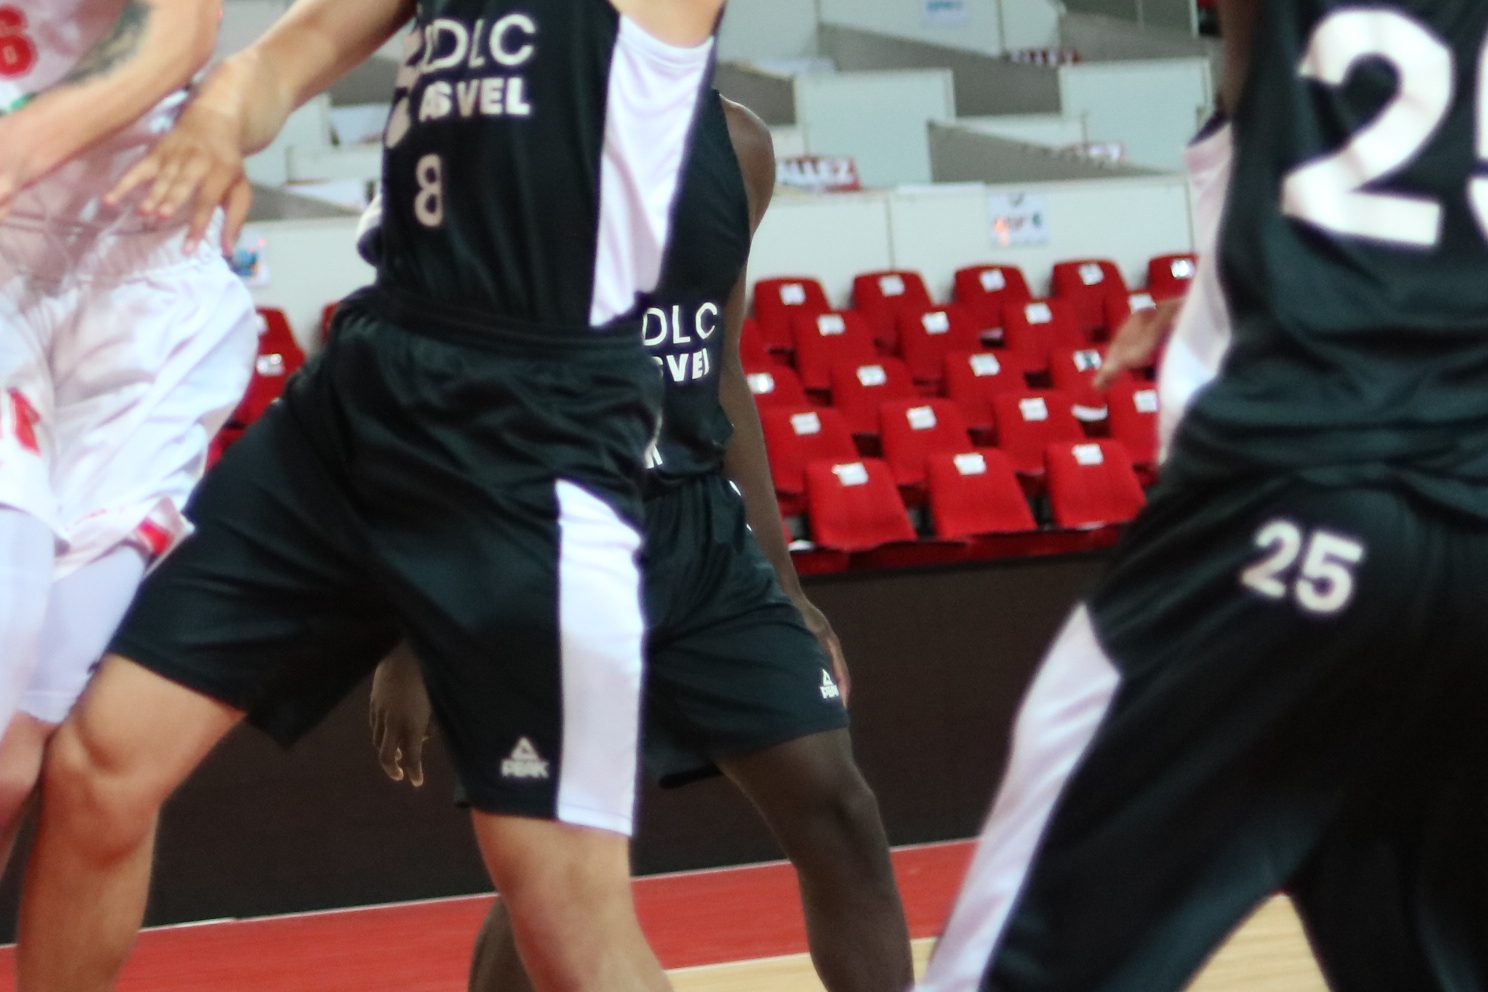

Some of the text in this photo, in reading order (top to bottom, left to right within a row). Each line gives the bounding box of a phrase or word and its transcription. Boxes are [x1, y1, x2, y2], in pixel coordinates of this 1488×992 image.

[1281, 8, 1488, 246] 2
[415, 154, 442, 227] 8
[1240, 519, 1365, 612] 25
